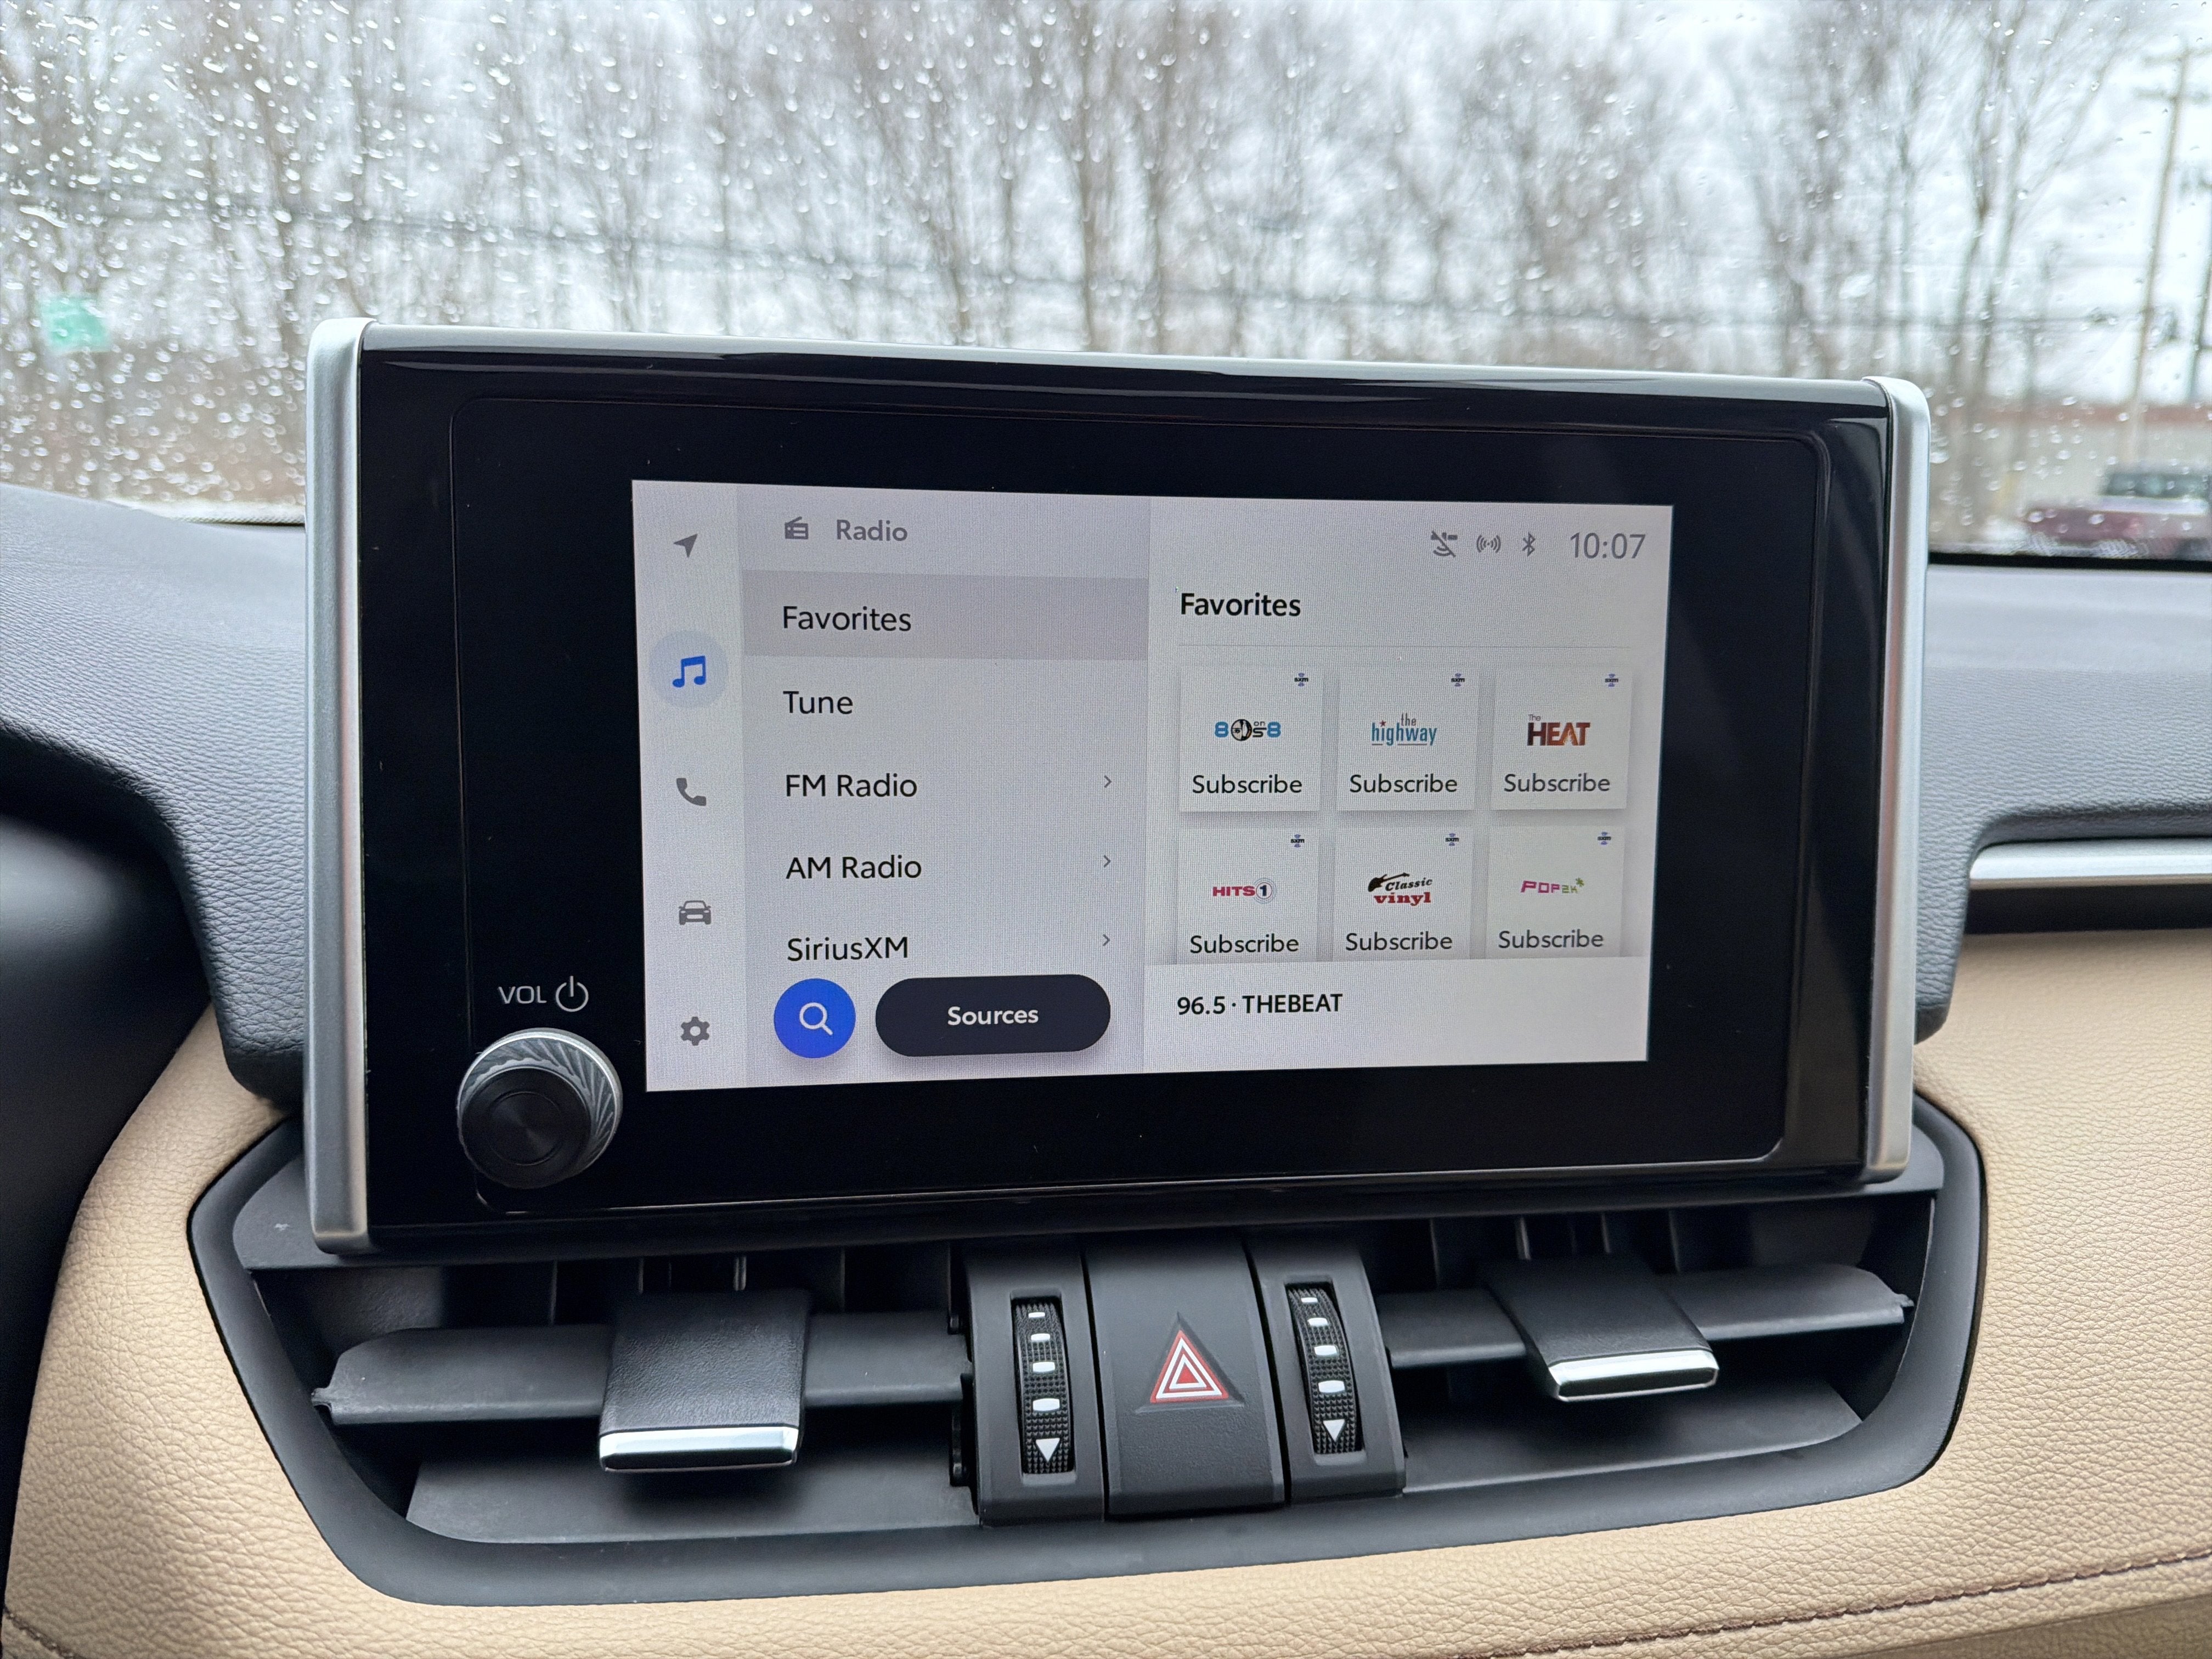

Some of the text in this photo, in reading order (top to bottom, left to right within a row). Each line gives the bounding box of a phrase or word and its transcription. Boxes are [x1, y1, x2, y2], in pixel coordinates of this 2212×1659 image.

[836, 518, 909, 542] Radio
[1570, 532, 1647, 560] 10:07
[1181, 592, 1302, 617] Favorites
[782, 605, 912, 632] Favorites
[782, 690, 854, 715] Tune
[1401, 713, 1417, 726] the
[1372, 722, 1437, 746] highway
[1527, 722, 1591, 746] HEAT
[786, 772, 918, 798] FM Radio
[1192, 774, 1303, 795] Subscribe
[1350, 773, 1458, 794] Subscribe
[1504, 772, 1611, 793] Subscribe
[786, 855, 923, 879] AM Radio
[1212, 884, 1267, 896] HITS 1
[1385, 877, 1433, 891] Classic
[1374, 891, 1431, 906] vinyl
[787, 936, 909, 962] SiriusXM
[1189, 933, 1300, 955] Subscribe
[1345, 931, 1453, 952] Subscribe
[1498, 929, 1605, 950] Subscribe
[498, 985, 548, 1005] VOL
[1176, 993, 1343, 1016] 96.5 THEBEAT
[947, 1005, 1039, 1026] Sources
